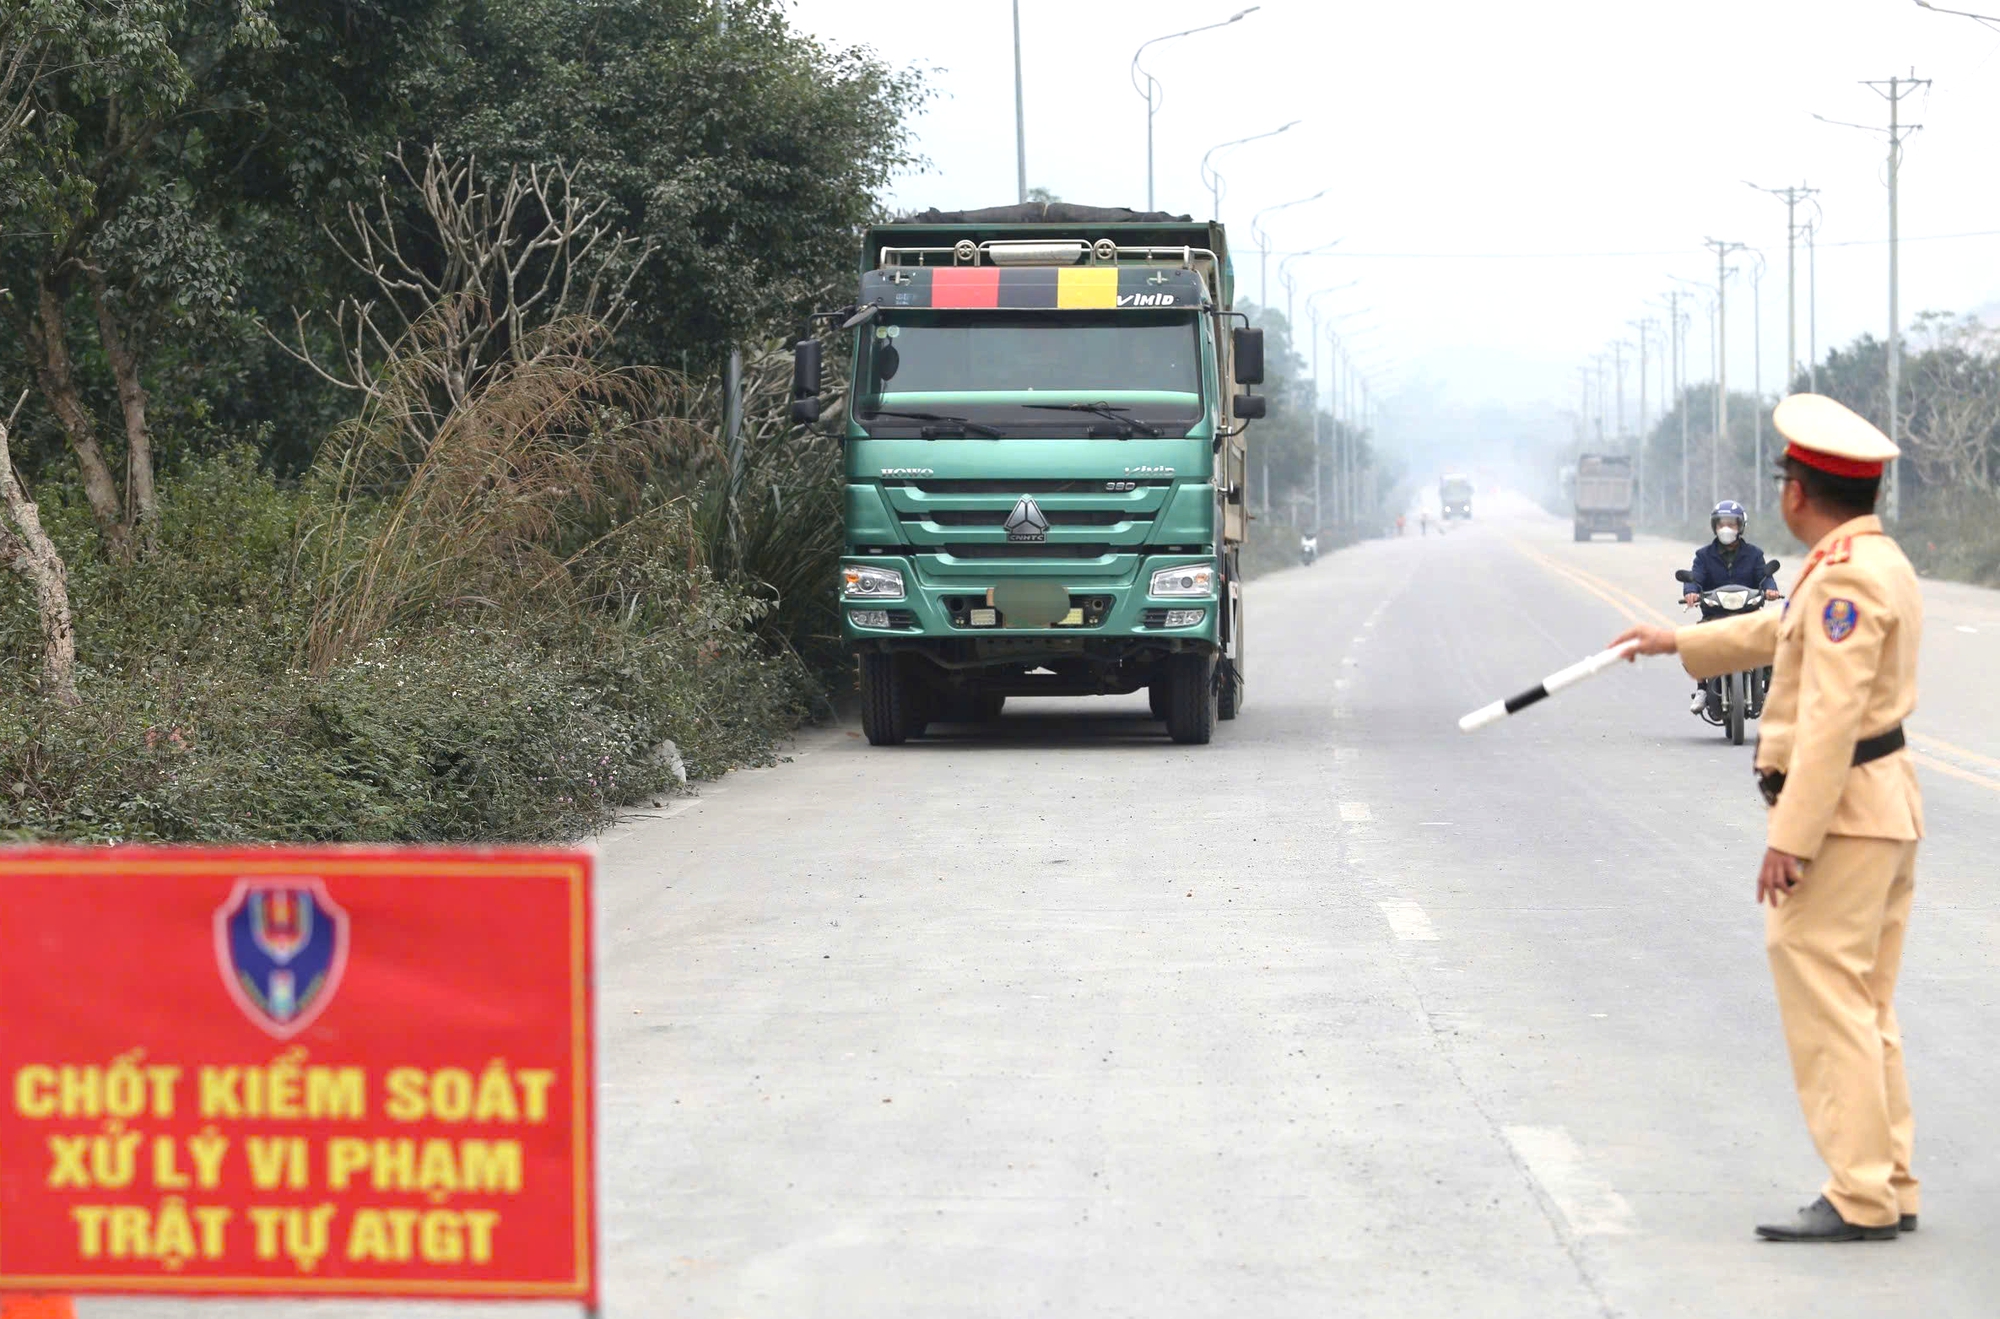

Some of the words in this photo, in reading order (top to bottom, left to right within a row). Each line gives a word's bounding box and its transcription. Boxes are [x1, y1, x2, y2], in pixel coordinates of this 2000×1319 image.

[881, 468, 934, 477] HOWO
[15, 1049, 180, 1118] CHỐT
[200, 1047, 365, 1120] KIỂM
[386, 1059, 554, 1122] SOÁT
[49, 1121, 141, 1188] XỬ
[154, 1127, 228, 1189] LÝ
[247, 1137, 309, 1189] VI
[328, 1138, 523, 1203] PHẠM
[73, 1196, 230, 1269] TRẬT
[250, 1203, 335, 1271] TỰ
[347, 1209, 499, 1262] ATGT
